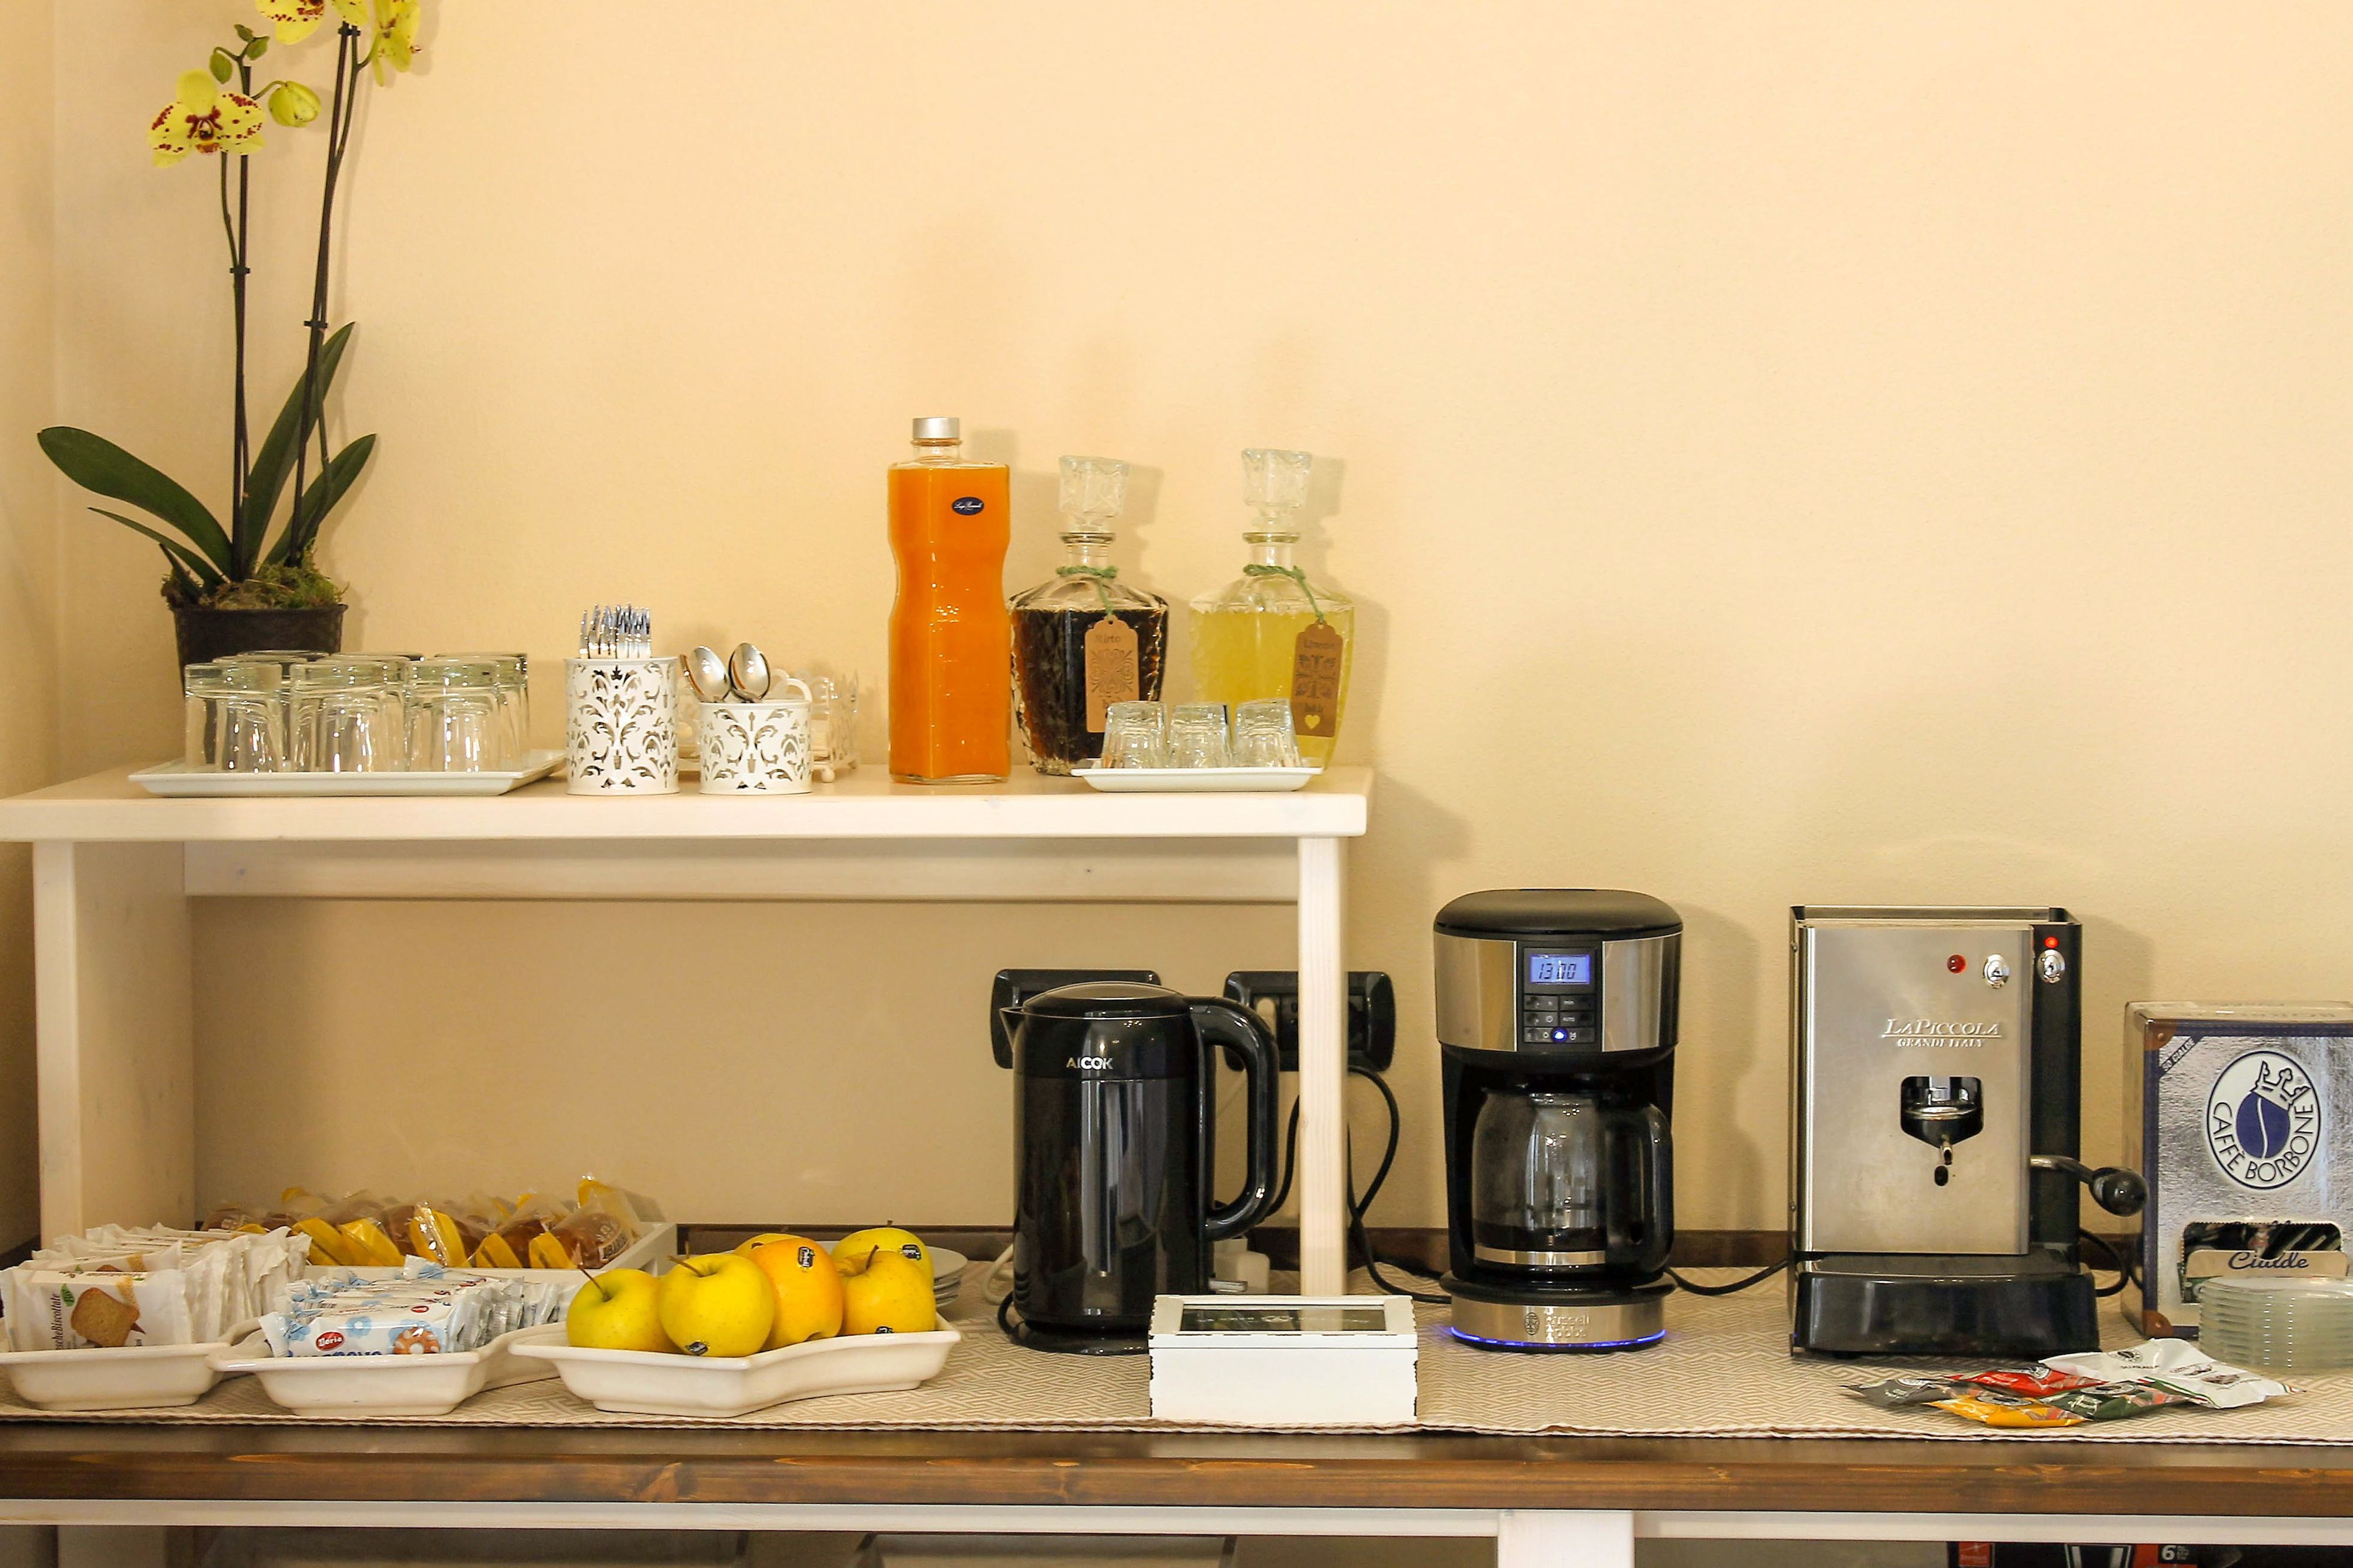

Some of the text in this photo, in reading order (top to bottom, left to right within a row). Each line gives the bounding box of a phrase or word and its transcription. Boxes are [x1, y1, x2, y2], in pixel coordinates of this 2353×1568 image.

[1066, 1057, 1114, 1070] AICOK
[2213, 1102, 2314, 1182] CAFFÈ BORBONE
[2161, 1544, 2177, 1561] 6
